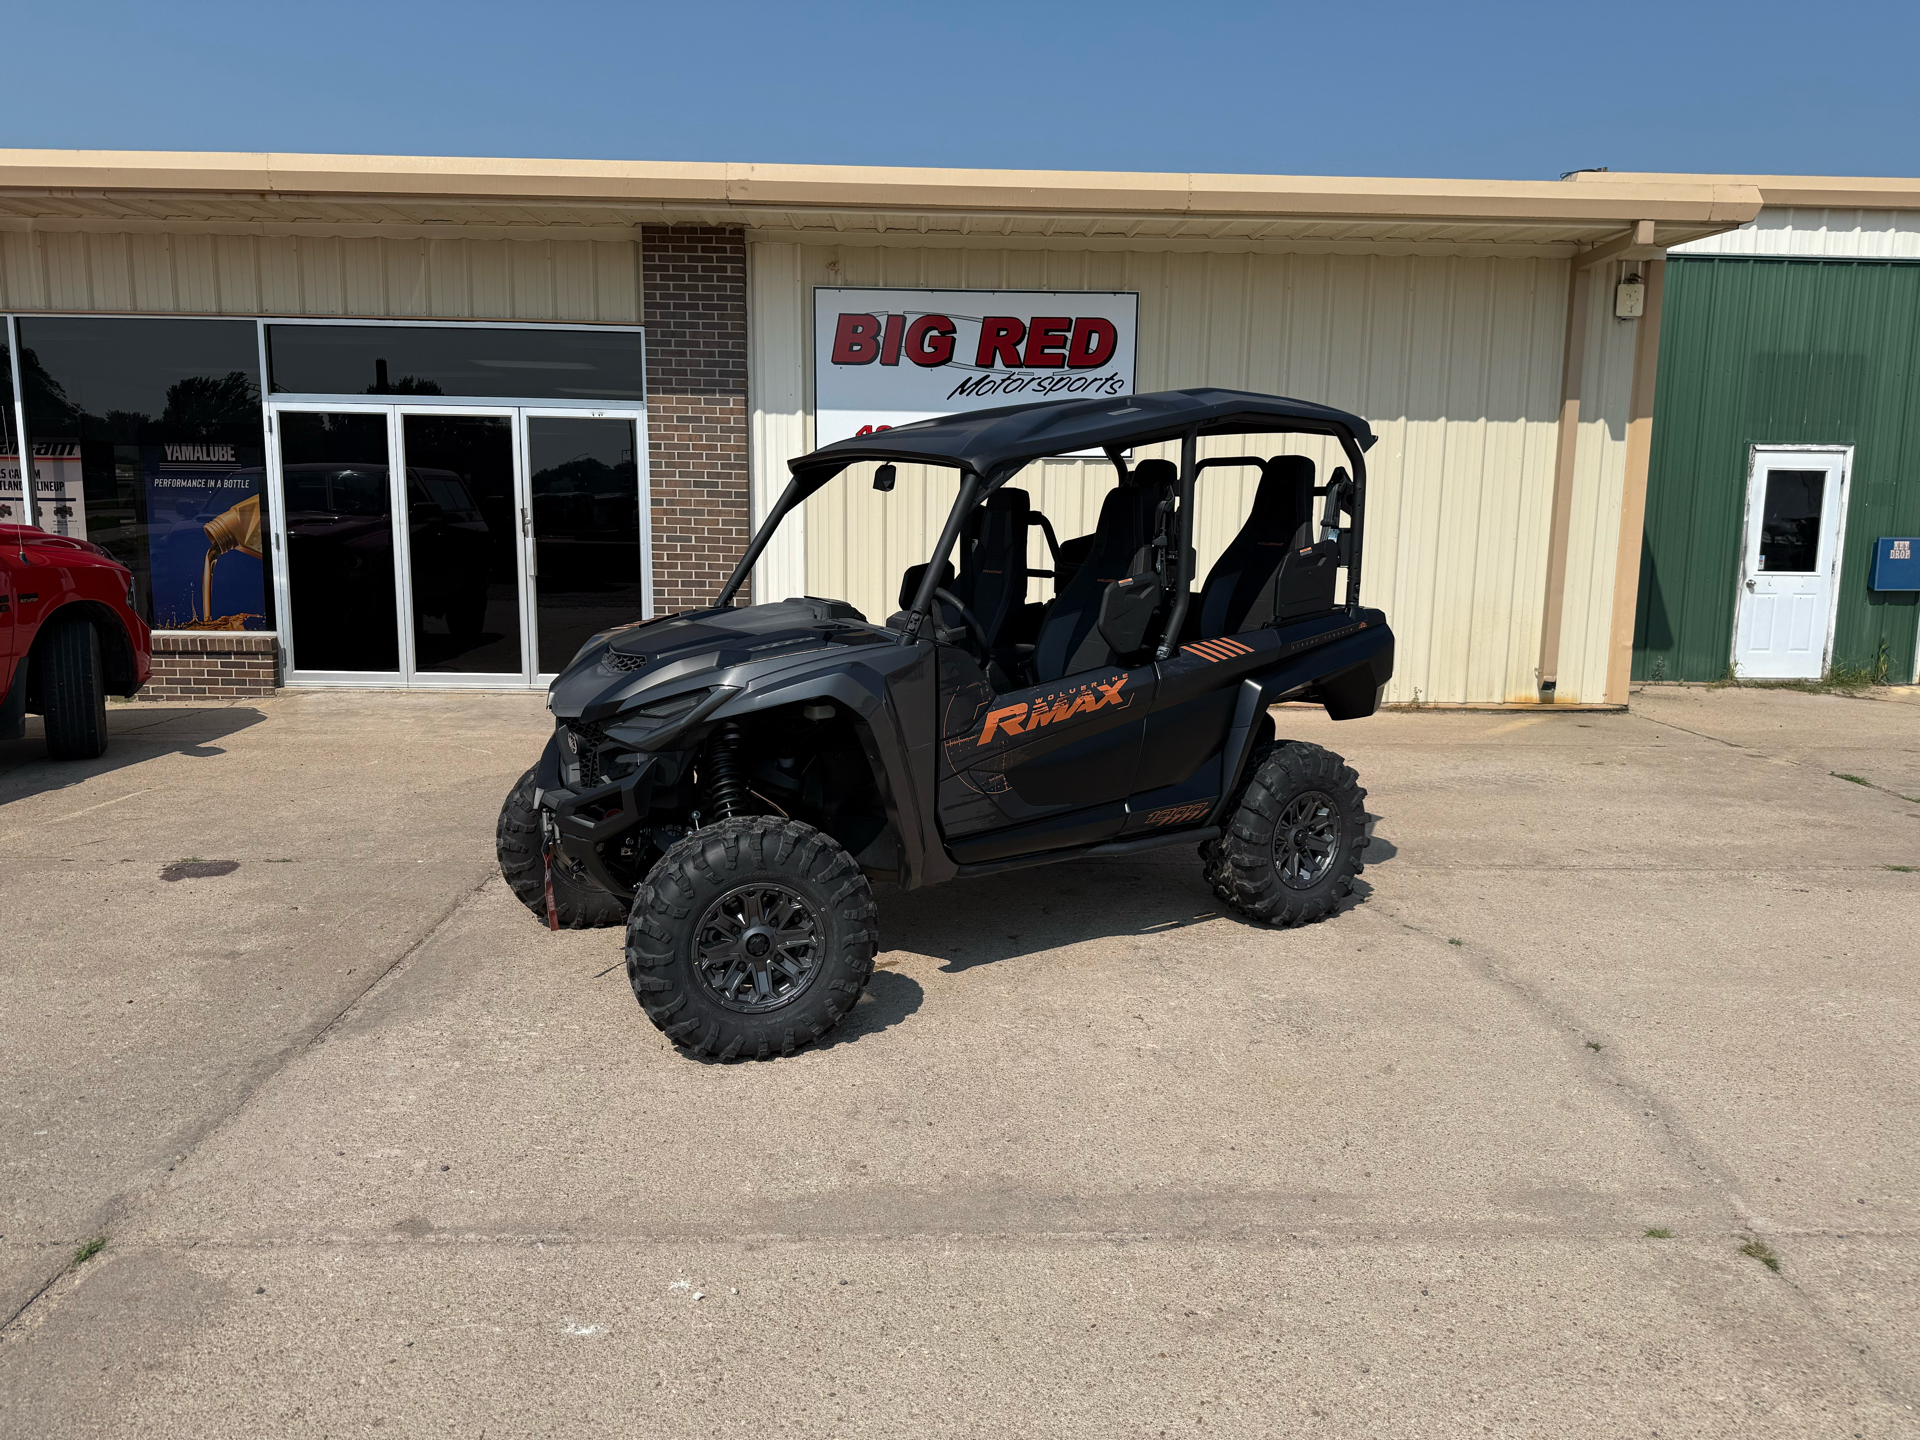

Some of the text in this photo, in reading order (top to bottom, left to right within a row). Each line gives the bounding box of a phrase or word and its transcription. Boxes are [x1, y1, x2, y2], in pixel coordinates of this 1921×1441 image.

[831, 313, 1118, 369] BIG RED
[947, 372, 1125, 400] Motorsports
[164, 443, 236, 461] YAMALUBE
[37, 481, 65, 492] LINEUP
[154, 479, 250, 489] PERFORMANCE IN A BOTTLE
[1894, 541, 1910, 550] KEY
[1890, 550, 1911, 559] DROP
[977, 678, 1129, 747] RMAX
